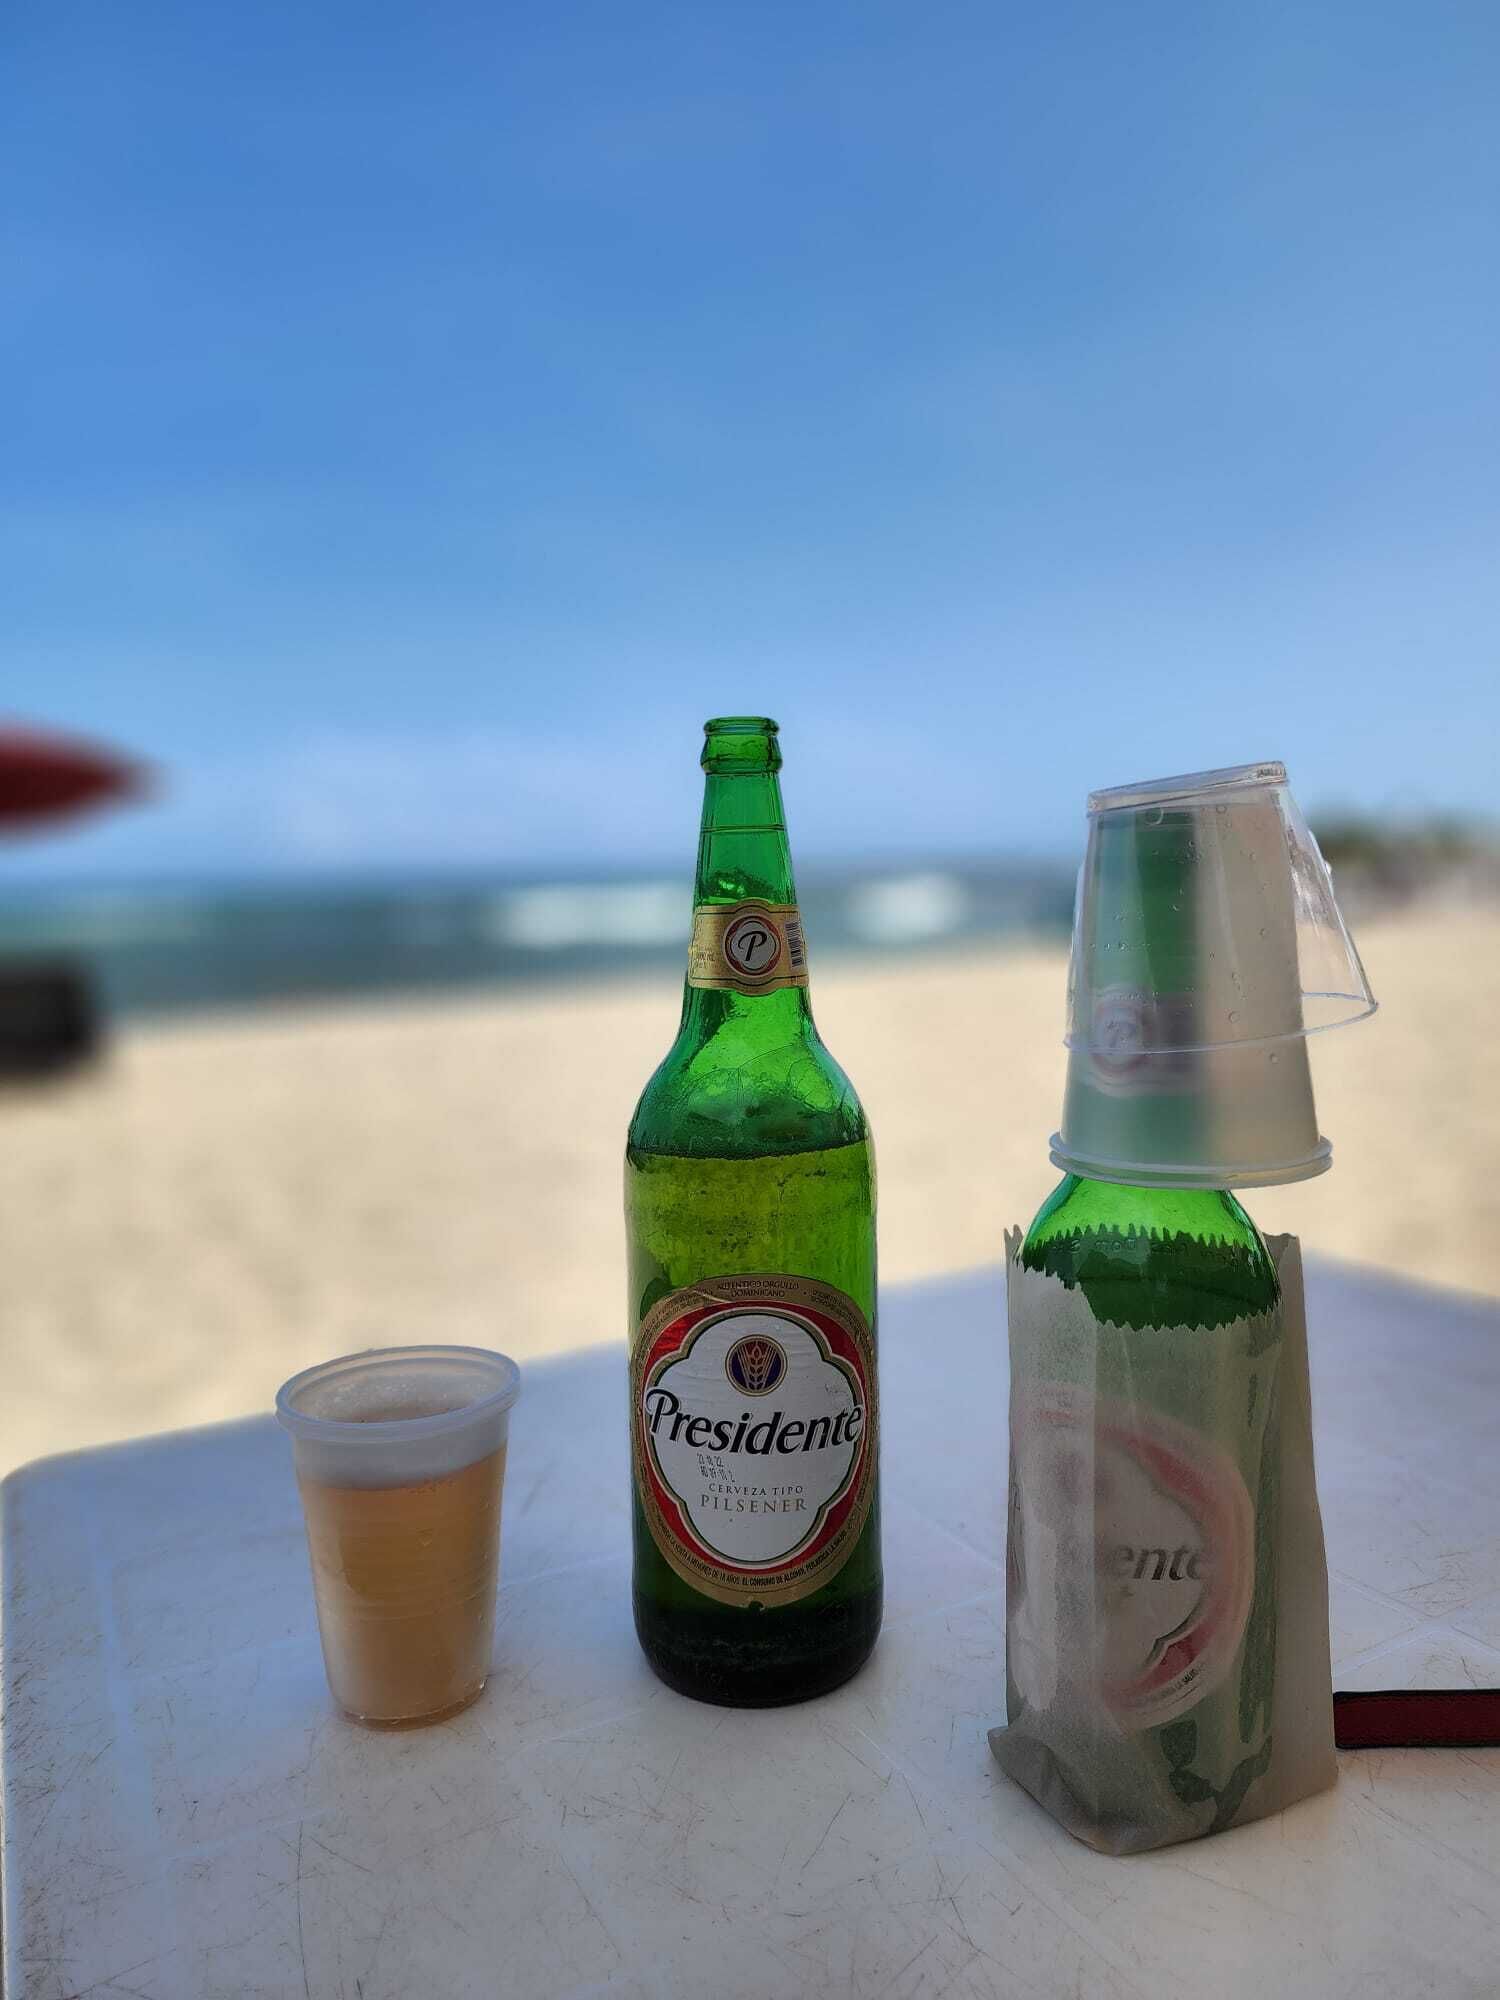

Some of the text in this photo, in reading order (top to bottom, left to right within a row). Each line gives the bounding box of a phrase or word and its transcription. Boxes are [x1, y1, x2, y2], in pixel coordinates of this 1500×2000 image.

[737, 930, 768, 962] P
[646, 1388, 862, 1455] Presidente
[708, 1482, 804, 1496] CERVEZA TIPO
[700, 1494, 808, 1513] PILSENER
